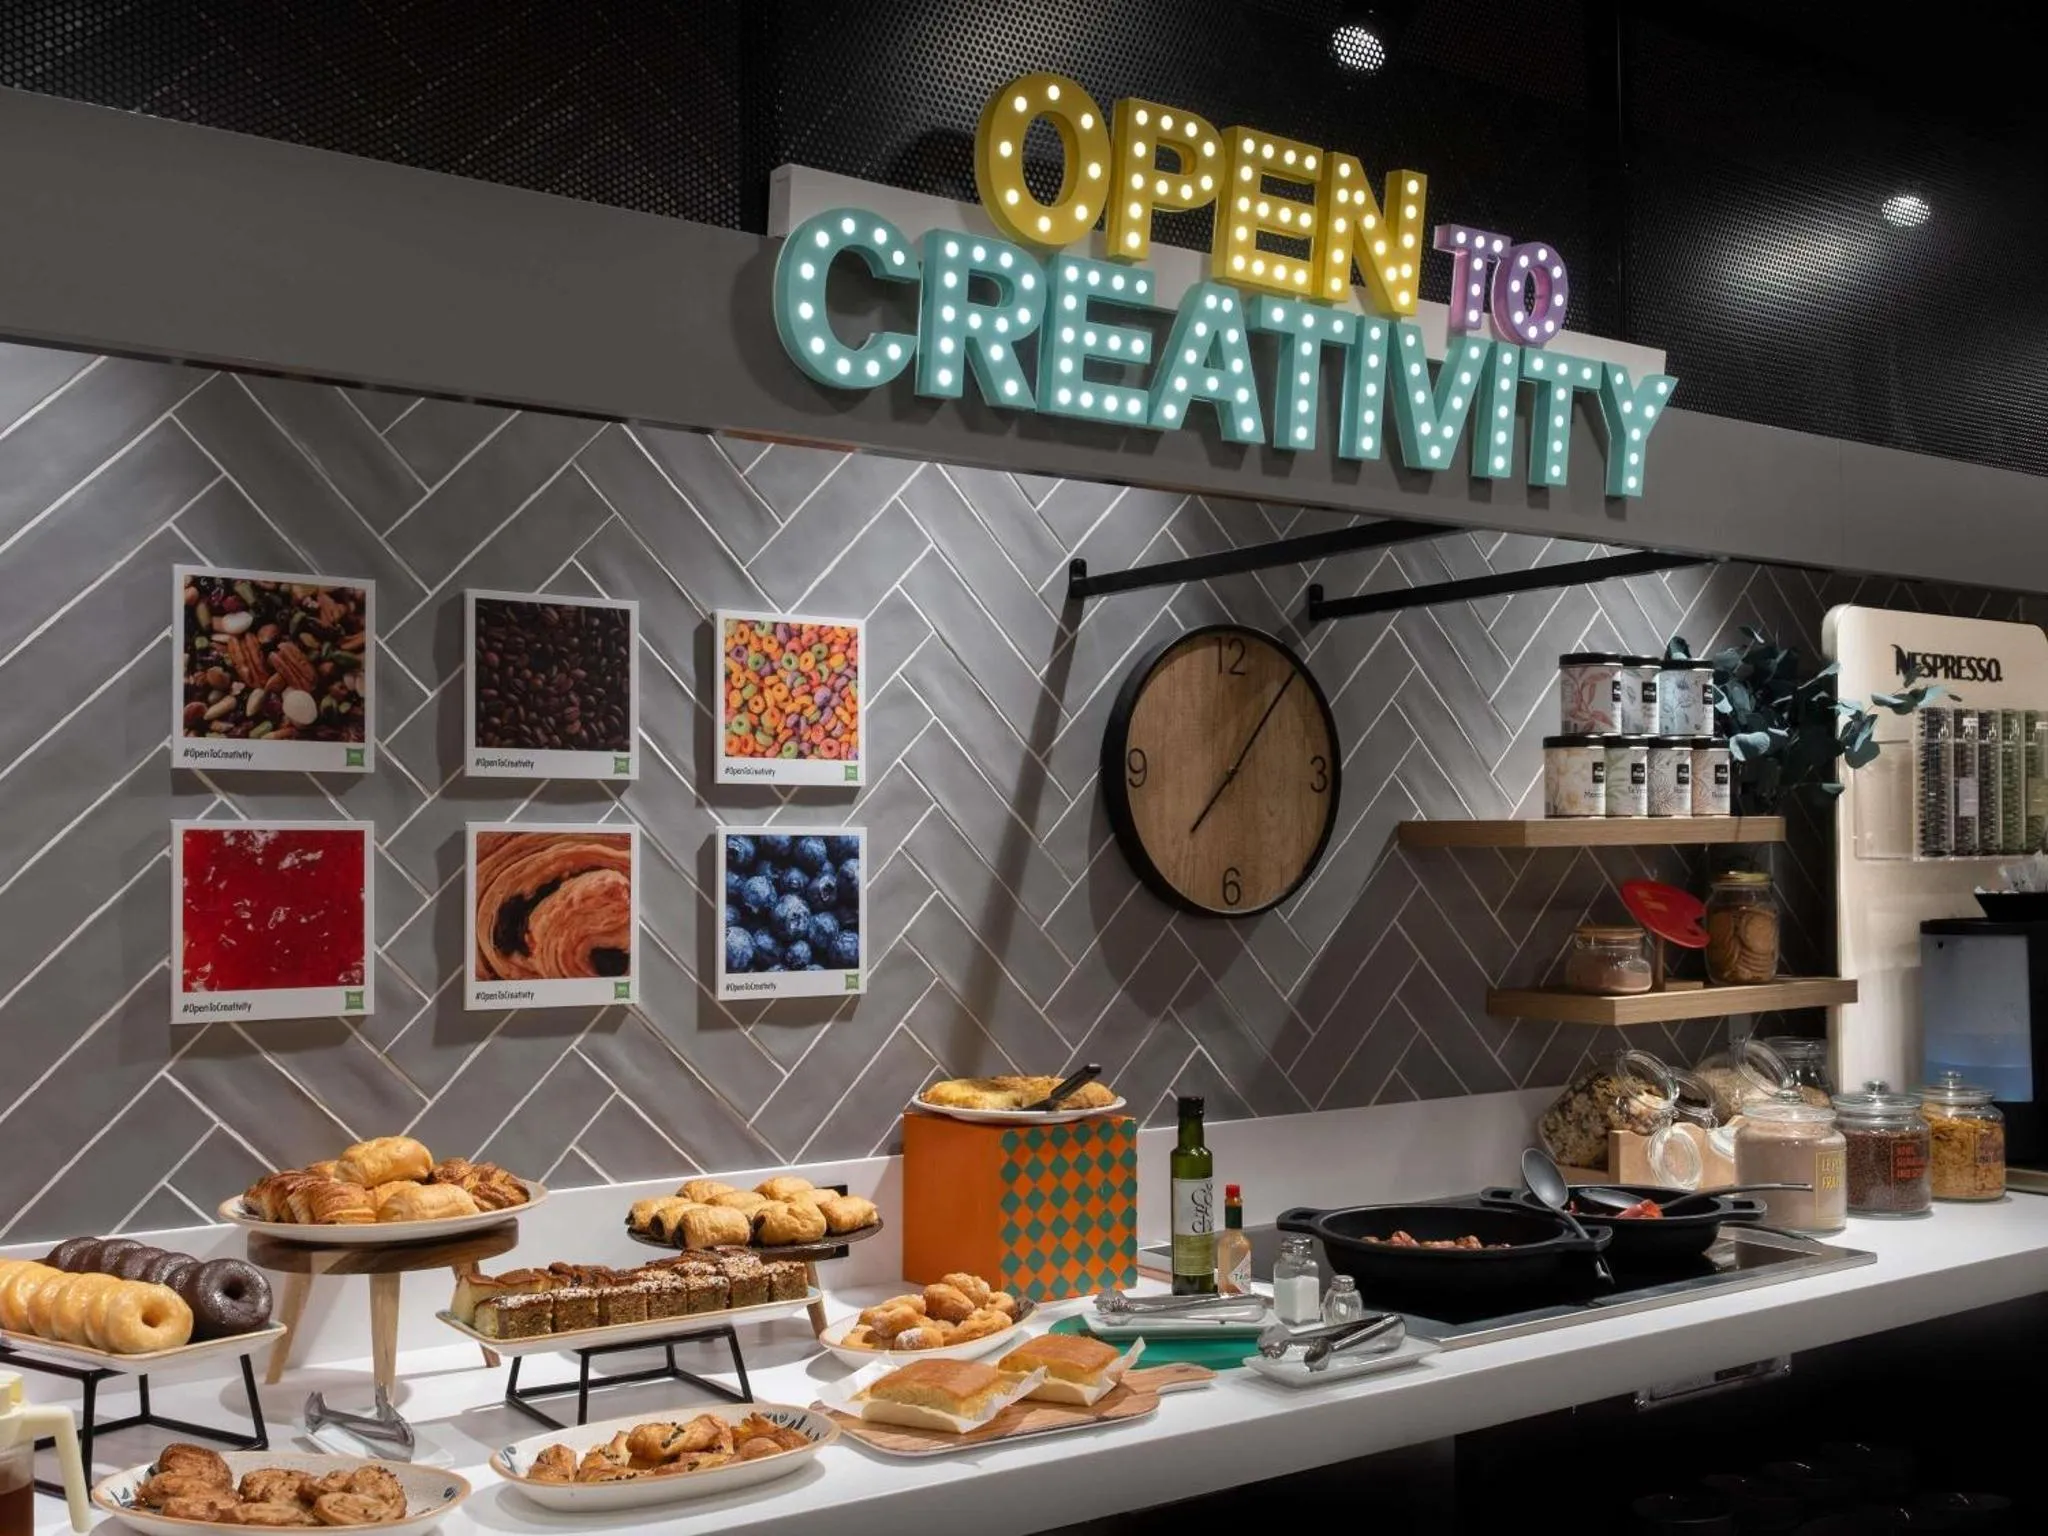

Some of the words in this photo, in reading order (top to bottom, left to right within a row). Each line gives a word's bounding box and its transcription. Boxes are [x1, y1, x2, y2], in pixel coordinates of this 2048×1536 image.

[975, 72, 1428, 316] OPEN
[1433, 223, 1570, 345] TO
[772, 207, 1679, 498] CREATIVITY
[1214, 636, 1246, 676] 12
[183, 747, 253, 762] #OpenToCreativity
[475, 756, 535, 771] #OpenToCreativity
[1127, 748, 1148, 788] 9
[724, 765, 776, 778] #OpenToCreativity
[1309, 755, 1329, 794] 3
[1221, 866, 1242, 906] 6
[475, 990, 535, 1003] #OpenToCreativity
[725, 981, 777, 993] #OpenToCreativity
[182, 1001, 252, 1015] #OpenToCreativity
